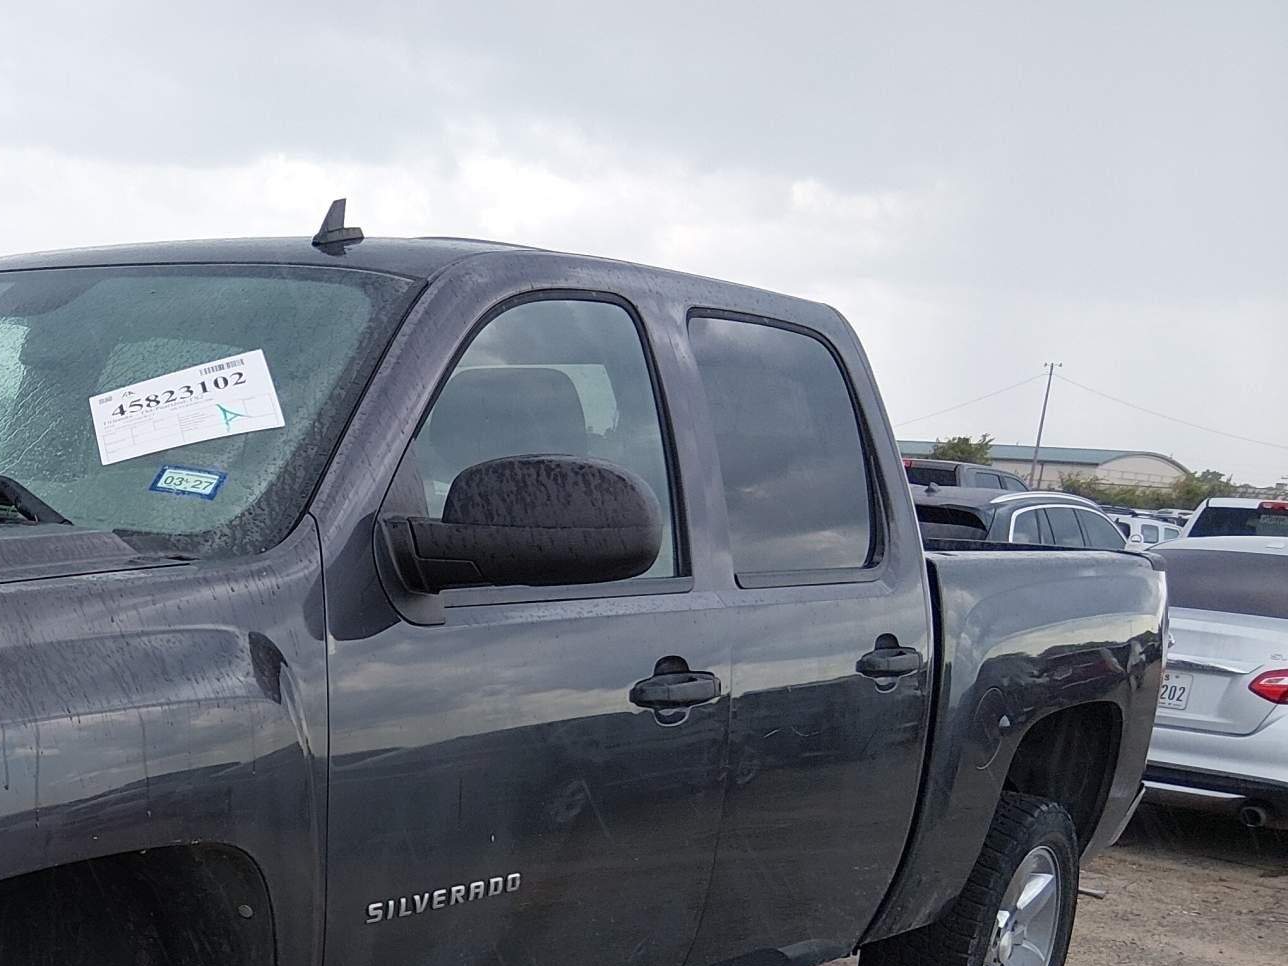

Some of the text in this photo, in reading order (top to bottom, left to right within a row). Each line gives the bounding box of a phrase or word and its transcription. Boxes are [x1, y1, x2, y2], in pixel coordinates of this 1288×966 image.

[111, 371, 247, 417] 45823102
[163, 475, 215, 491] 03 27
[366, 872, 522, 924] SILVERADO
